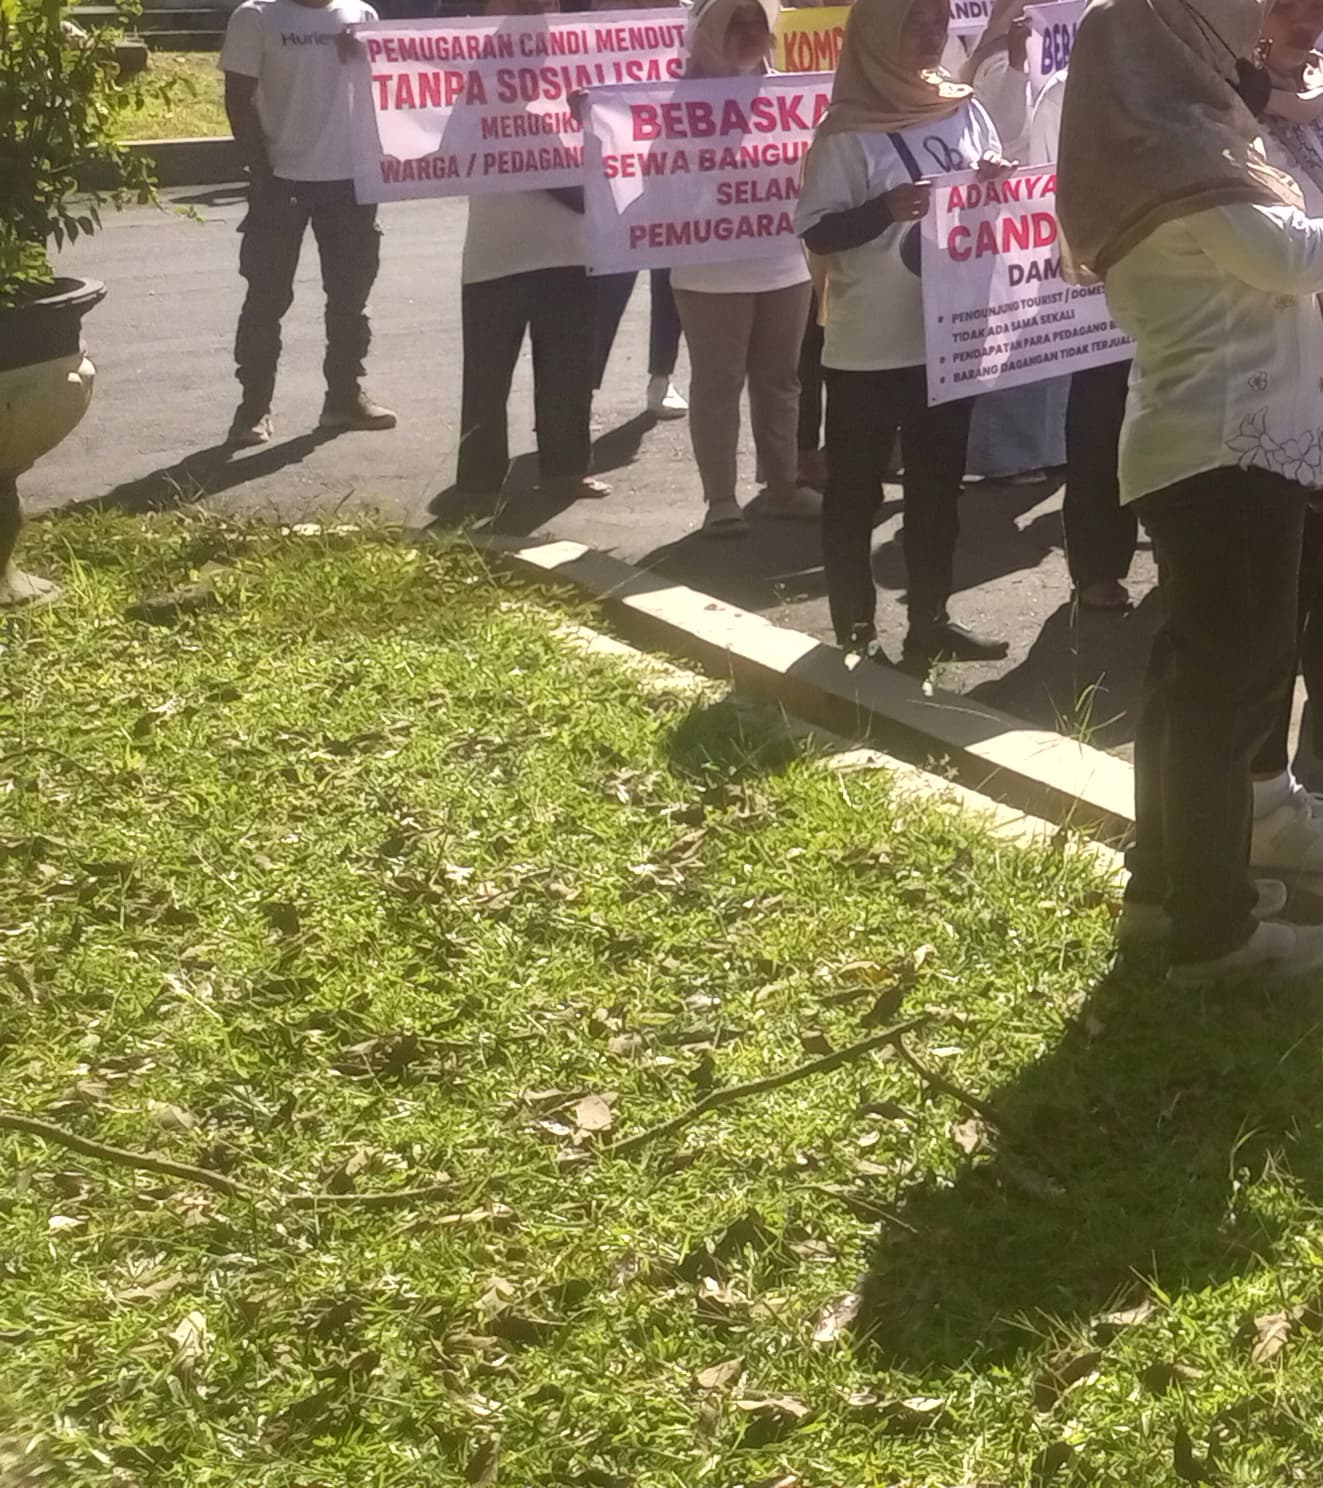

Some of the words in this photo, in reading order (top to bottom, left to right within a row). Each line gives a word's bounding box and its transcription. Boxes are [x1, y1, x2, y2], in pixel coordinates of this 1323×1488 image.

[948, 1, 988, 20] ANDI
[280, 30, 331, 47] Hurle
[368, 33, 514, 63] PEMUGARAN
[519, 29, 589, 57] CANDI
[595, 24, 686, 54] MENDUT
[372, 69, 487, 110] TANPA
[495, 57, 685, 104] SOSIALISAS
[481, 112, 583, 140] MERUGIK
[630, 93, 833, 142] BEBASKA
[380, 155, 461, 184] WARGA
[604, 150, 691, 179] SEWA
[699, 141, 809, 172] BANGU
[716, 177, 803, 205] SELAM
[947, 173, 1057, 213] ADANYA
[630, 212, 796, 249] PEMUGARA
[947, 212, 1057, 262] CAND
[1008, 258, 1062, 287] DAM
[952, 300, 1020, 324] PENGUNJUNG
[1021, 290, 1063, 310] TOURIST
[953, 326, 986, 343] TIDAK
[987, 323, 1010, 337] ADA
[1040, 309, 1076, 327] SEKALI
[953, 341, 1023, 364] PENDAPATAN
[1023, 334, 1050, 348] PARA
[953, 364, 998, 383] BARANG
[1060, 345, 1090, 361] TIDAK
